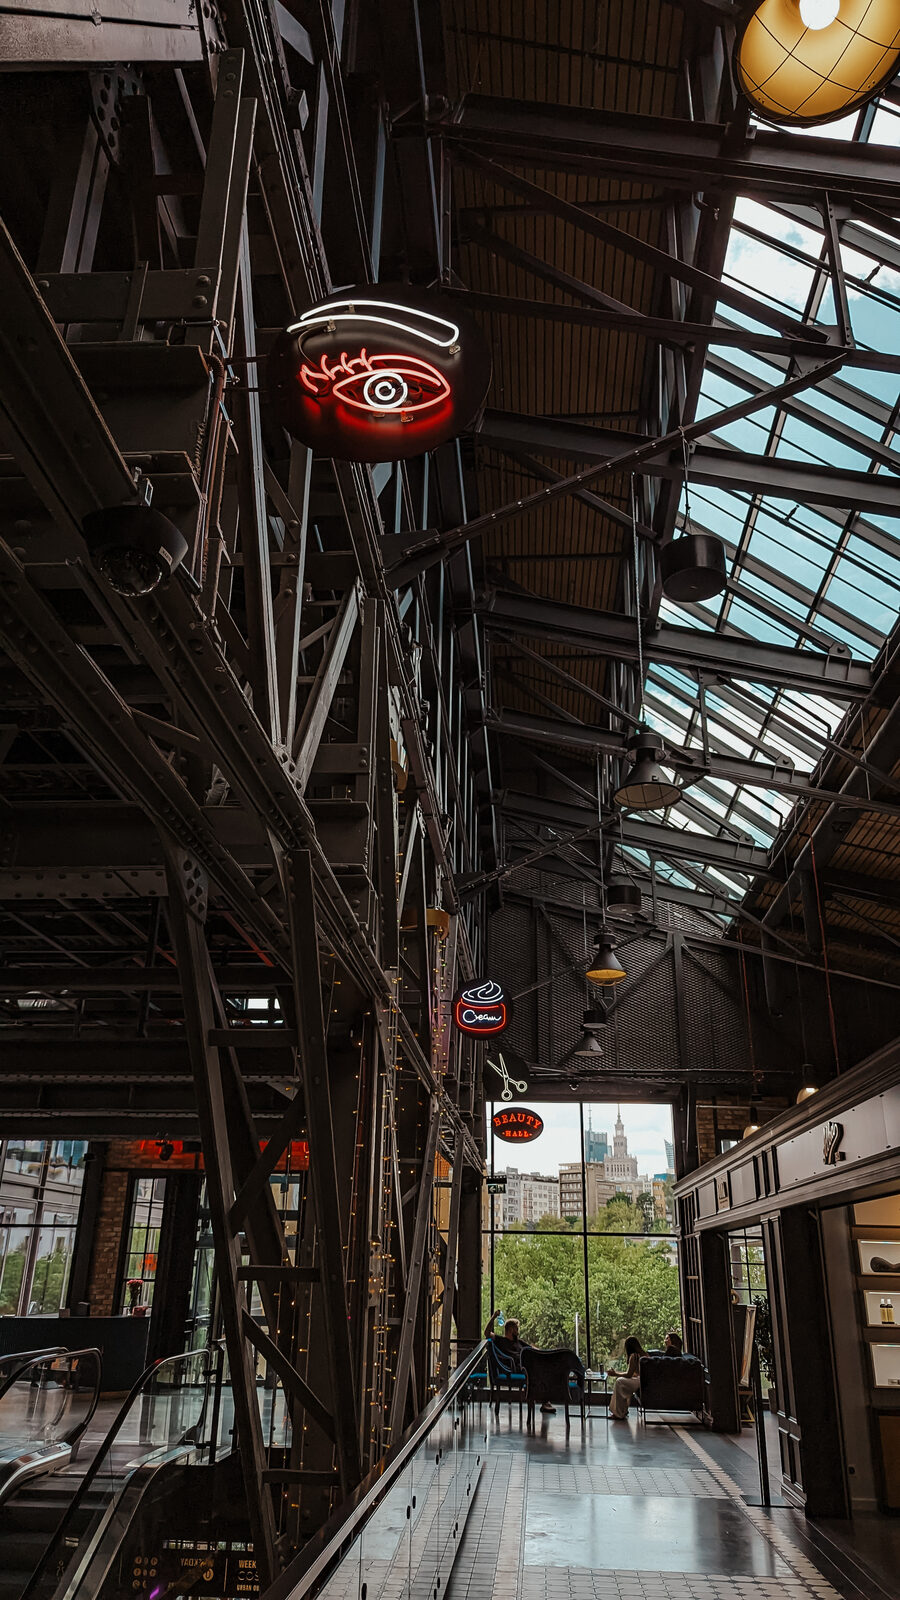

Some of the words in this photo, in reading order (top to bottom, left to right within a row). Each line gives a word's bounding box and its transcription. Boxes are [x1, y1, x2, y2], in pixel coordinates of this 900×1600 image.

[462, 1009, 502, 1023] Cream
[493, 1113, 542, 1129] BEAUTY
[505, 1130, 529, 1138] HALL
